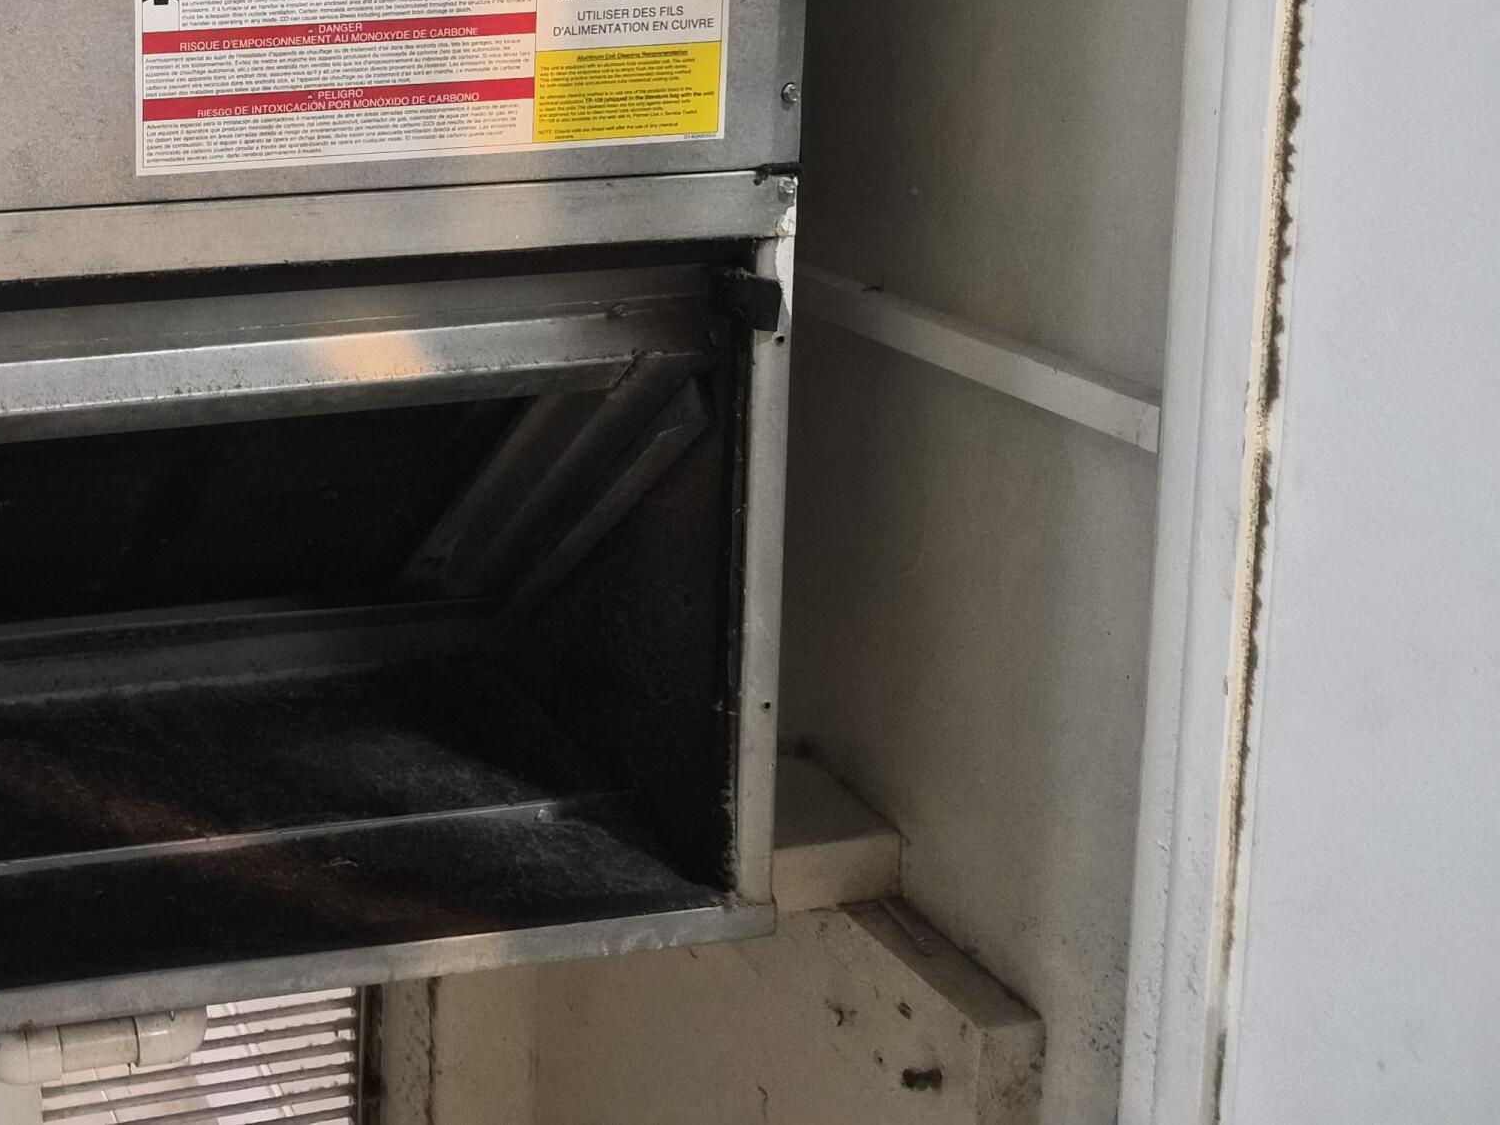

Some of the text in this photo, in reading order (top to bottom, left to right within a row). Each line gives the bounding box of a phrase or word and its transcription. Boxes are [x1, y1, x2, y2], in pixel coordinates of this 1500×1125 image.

[578, 6, 683, 21] UTILISER DES FILS
[318, 23, 362, 33] DANGER
[553, 18, 714, 36] D'ALIMENTATION EN CUIVRE
[180, 28, 478, 51] RISQUE D'EMPOISONNEMENT AU MONOXYDE DE CARBONE
[318, 89, 363, 99] PELIGRO
[197, 107, 232, 117] RIESGO
[234, 106, 249, 115] DE
[328, 100, 350, 110] POR
[412, 96, 425, 105] DE
[429, 93, 479, 104] CARBONO
